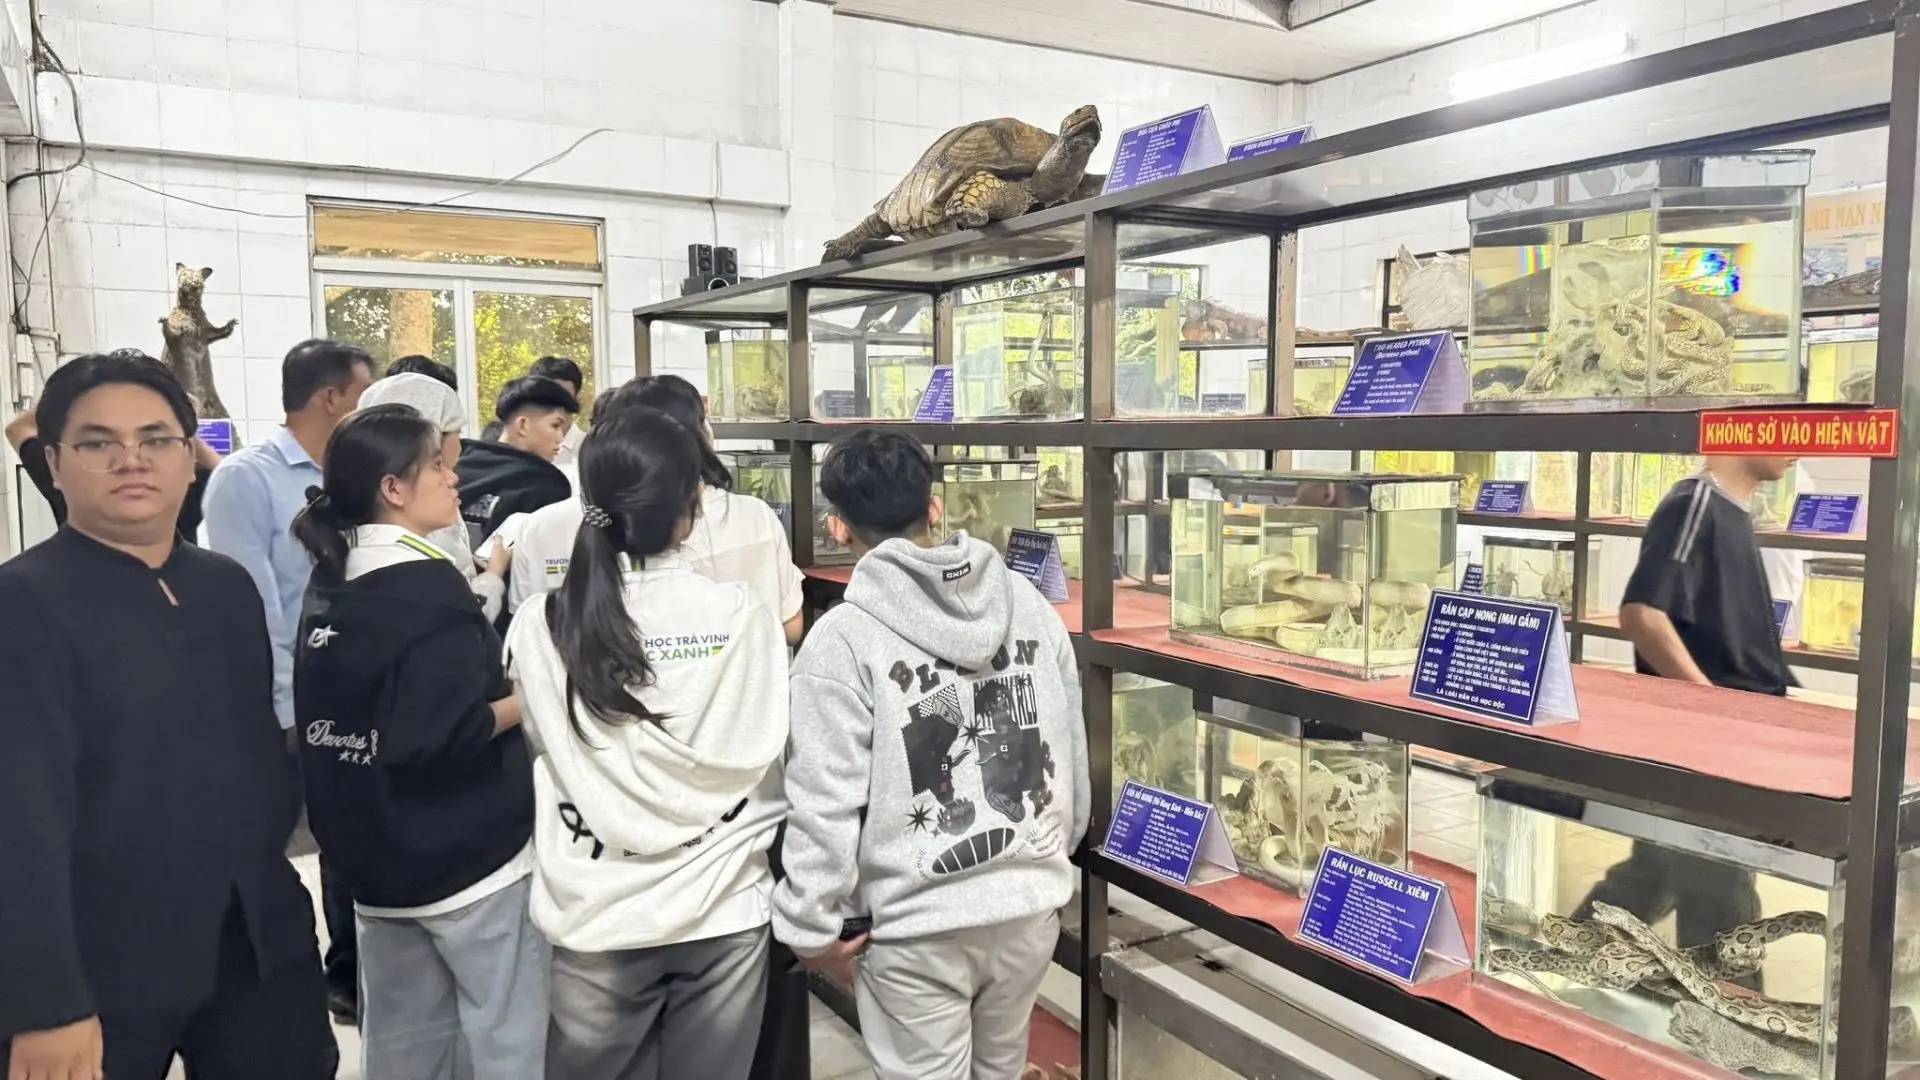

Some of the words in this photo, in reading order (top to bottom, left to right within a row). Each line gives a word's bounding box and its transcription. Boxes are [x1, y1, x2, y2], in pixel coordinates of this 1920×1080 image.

[1705, 417, 1753, 445] KHÔNG
[1756, 416, 1777, 445] SỜ
[1780, 416, 1811, 445] VÀO
[1815, 416, 1852, 450] HIỆN
[1857, 416, 1891, 450] VẬT
[645, 636, 673, 649] HỌC
[675, 633, 699, 646] TRÀ
[701, 633, 730, 644] VINH
[660, 646, 709, 661] XANH
[1331, 857, 1348, 872] RẮN
[1348, 863, 1366, 878] LỤC
[1366, 870, 1404, 893] RUSSELL
[1405, 884, 1430, 902] XIÊM
